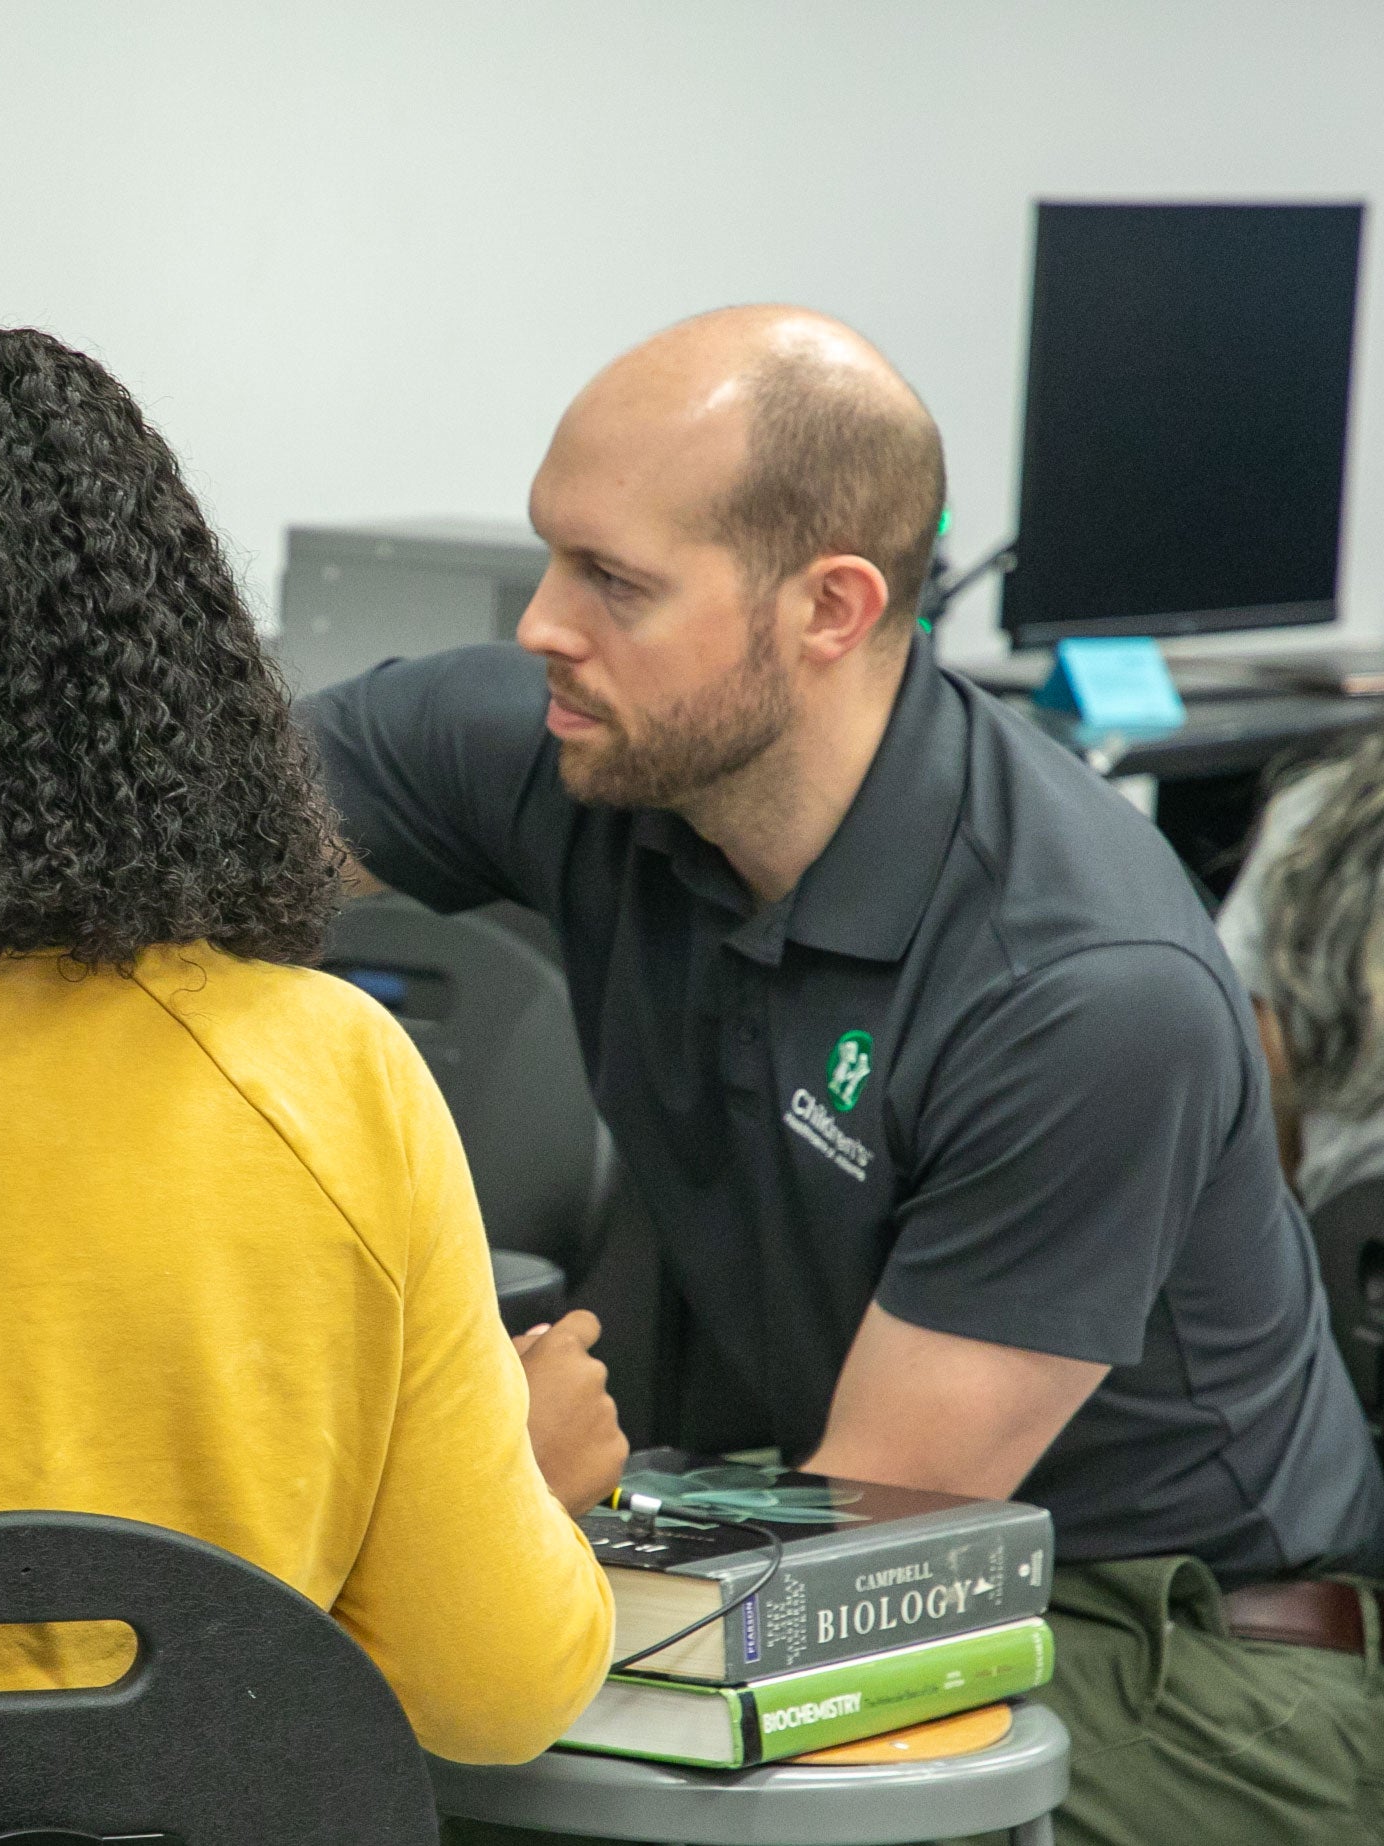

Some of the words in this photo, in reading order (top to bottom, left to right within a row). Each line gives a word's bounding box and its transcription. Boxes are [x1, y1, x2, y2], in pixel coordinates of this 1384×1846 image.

[855, 1562, 933, 1592] CAMPBELL
[745, 1601, 755, 1654] PEARSON
[817, 1579, 972, 1644] BIOLOGY
[762, 1692, 862, 1734] BIOCHEMISTRY
